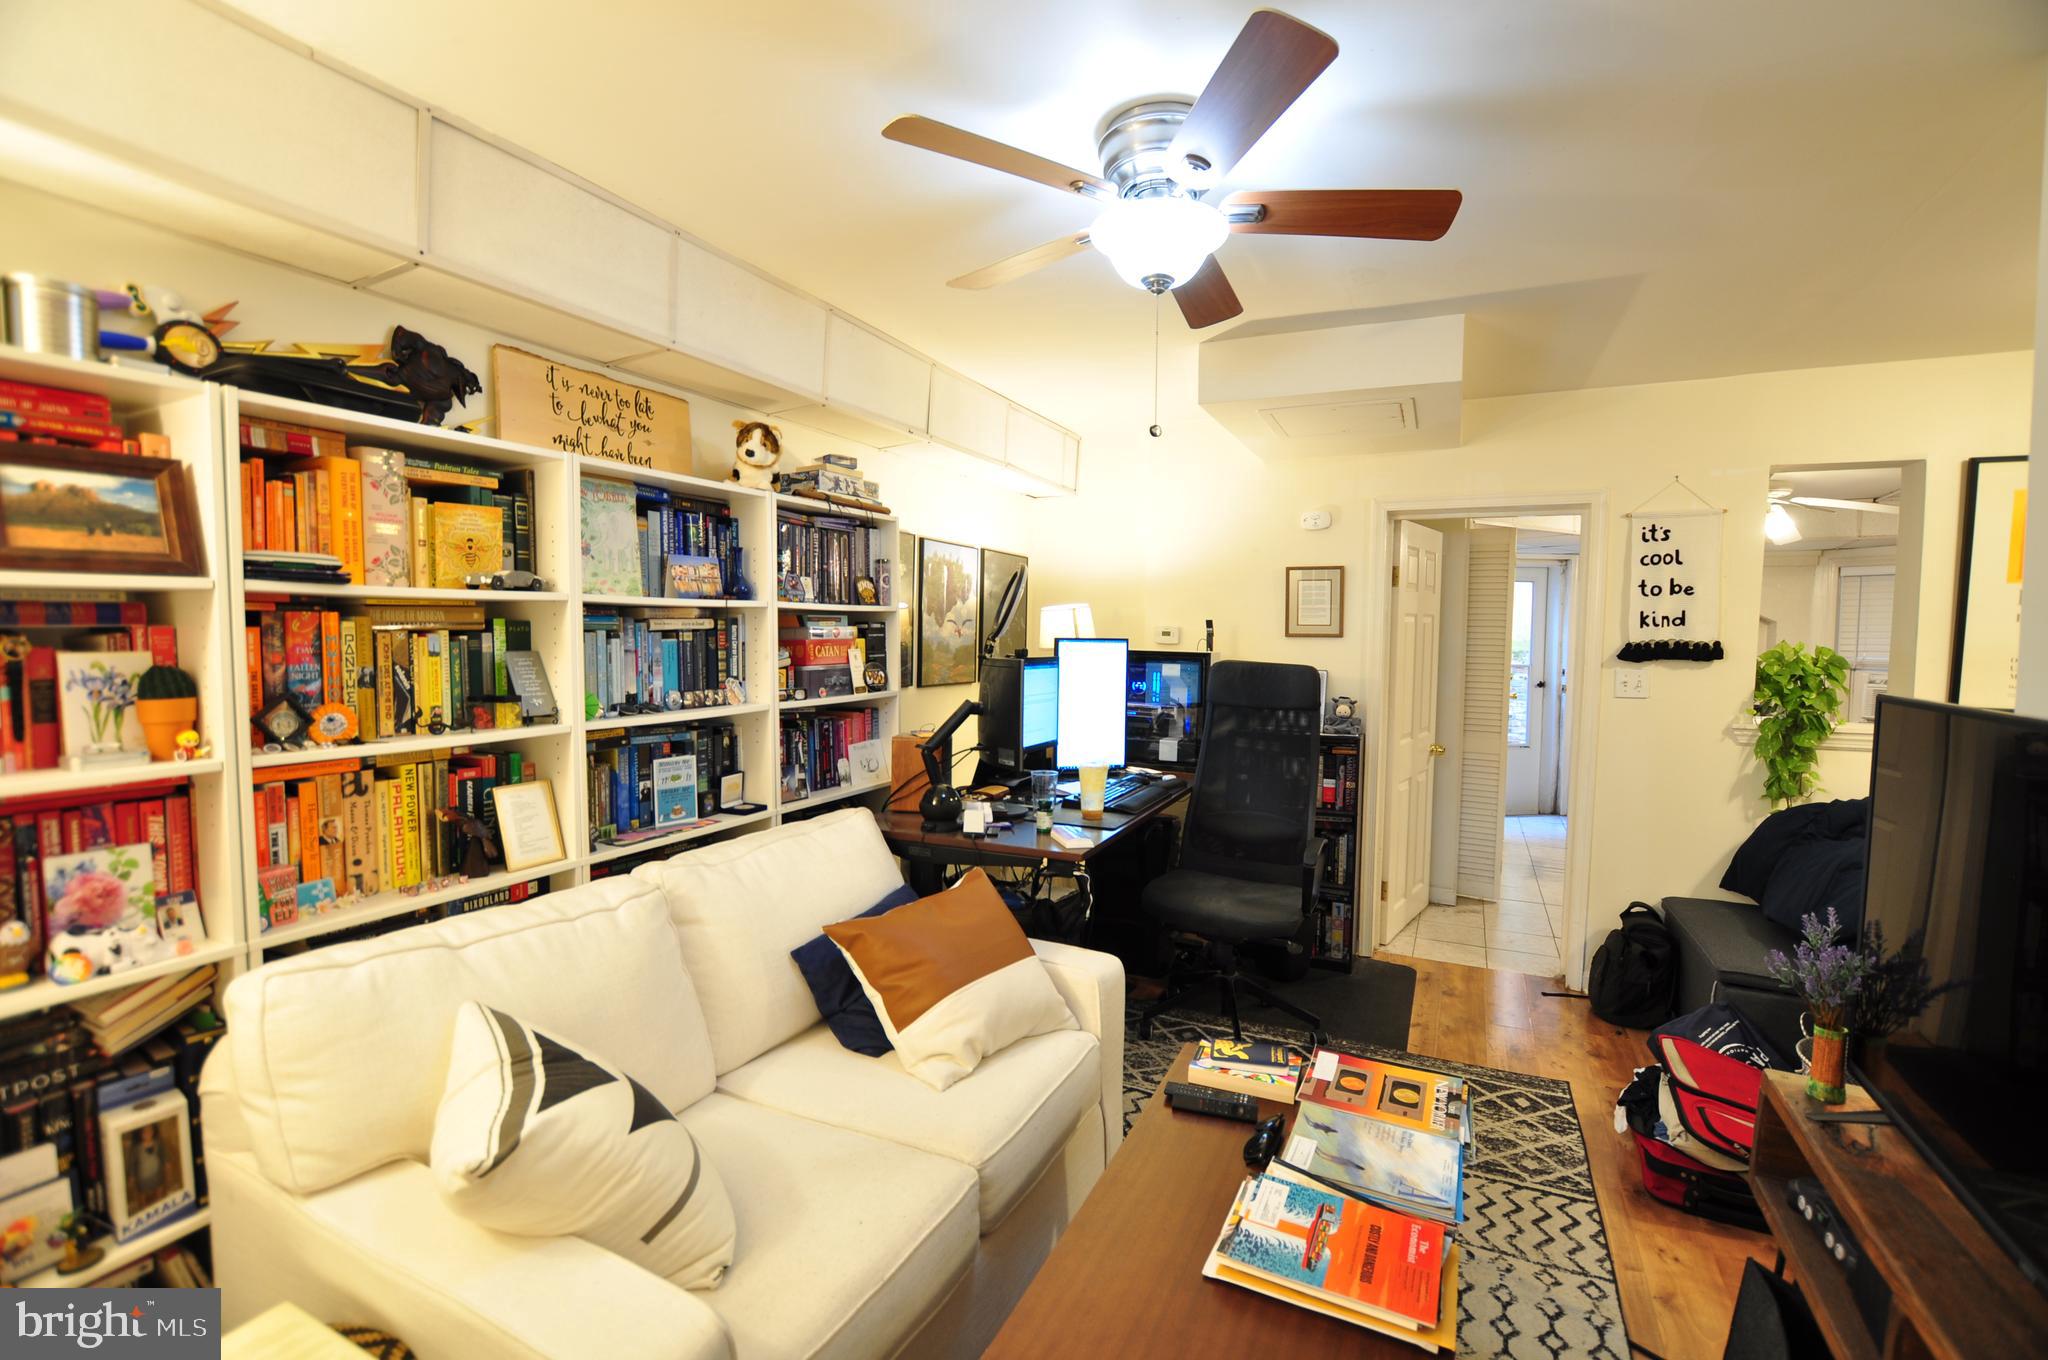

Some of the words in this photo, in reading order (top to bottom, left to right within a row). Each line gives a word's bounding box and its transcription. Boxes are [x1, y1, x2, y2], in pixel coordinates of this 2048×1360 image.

[546, 365, 560, 391] it
[561, 377, 574, 392] is
[579, 384, 612, 402] never
[615, 389, 631, 411] too
[634, 390, 655, 421] late
[549, 393, 563, 415] to
[593, 402, 625, 436] what
[628, 420, 652, 439] you
[552, 426, 593, 456] might
[594, 436, 625, 461] have
[627, 441, 652, 469] been
[1641, 523, 1671, 543] it's
[1639, 549, 1683, 566] cool
[1637, 579, 1662, 597] to
[1669, 577, 1695, 596] be
[1639, 610, 1686, 628] kind
[815, 645, 840, 657] CATAN
[404, 768, 415, 791] NEW
[406, 795, 417, 833] POWER
[463, 890, 511, 912] NIXONLAND
[121, 1191, 192, 1235] KAMALA
[1407, 1223, 1422, 1264] Economist
[1419, 1240, 1430, 1254] The
